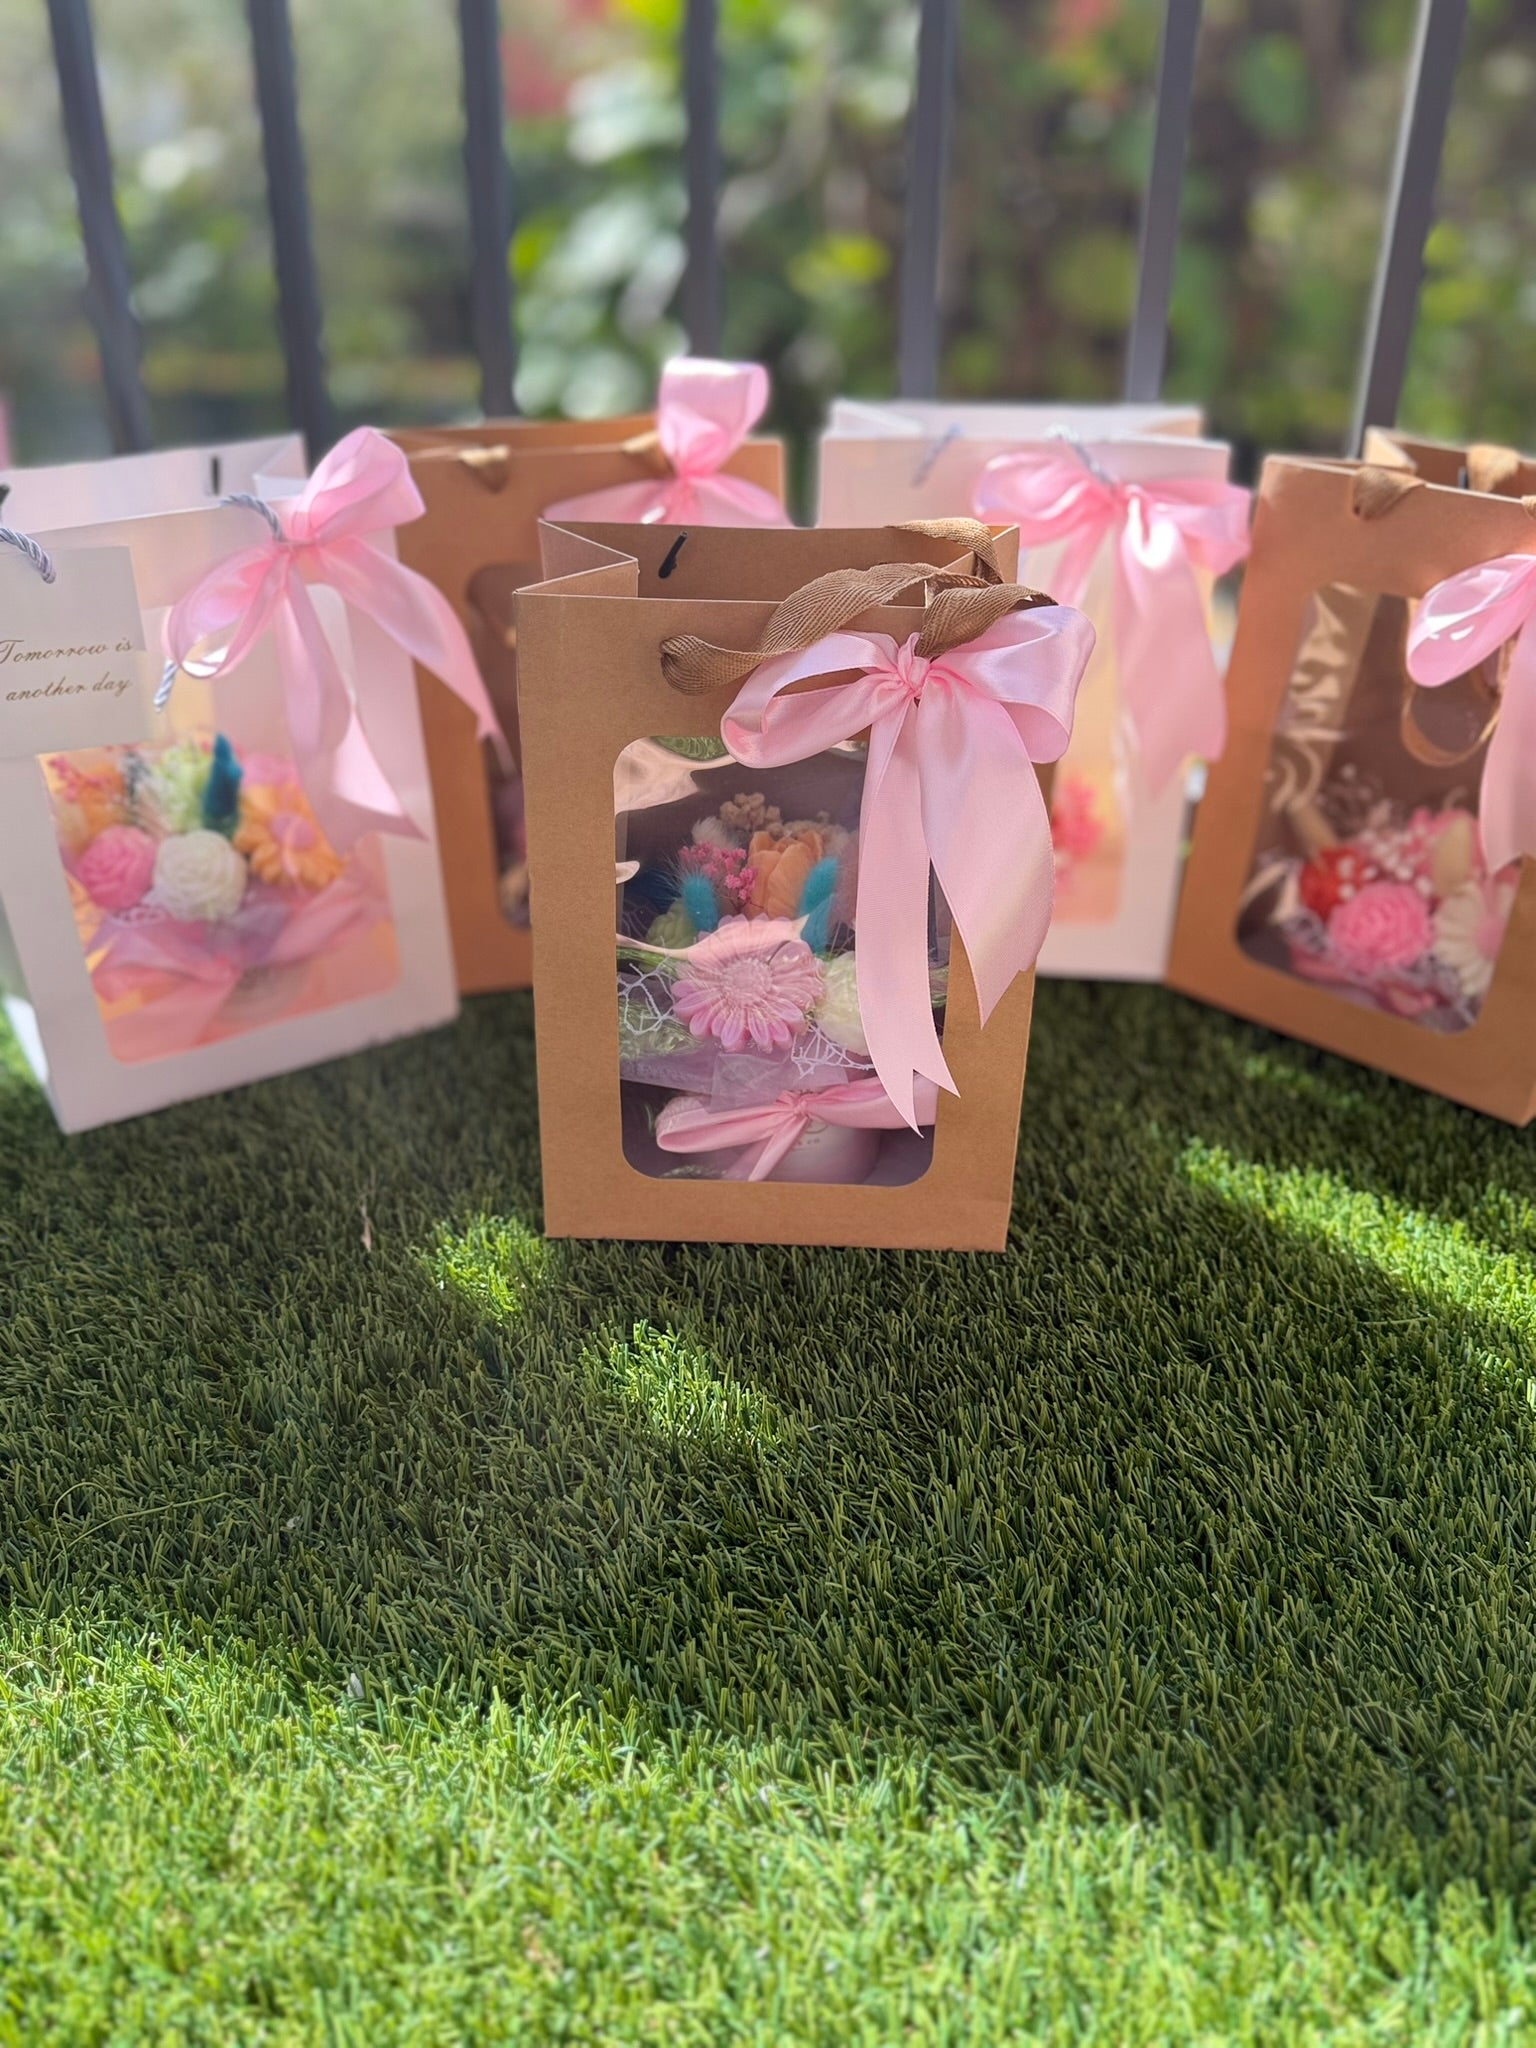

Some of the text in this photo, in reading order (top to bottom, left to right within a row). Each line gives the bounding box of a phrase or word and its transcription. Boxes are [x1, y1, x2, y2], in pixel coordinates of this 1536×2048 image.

[0, 637, 134, 665] Tomorrow is
[6, 671, 131, 701] another day
